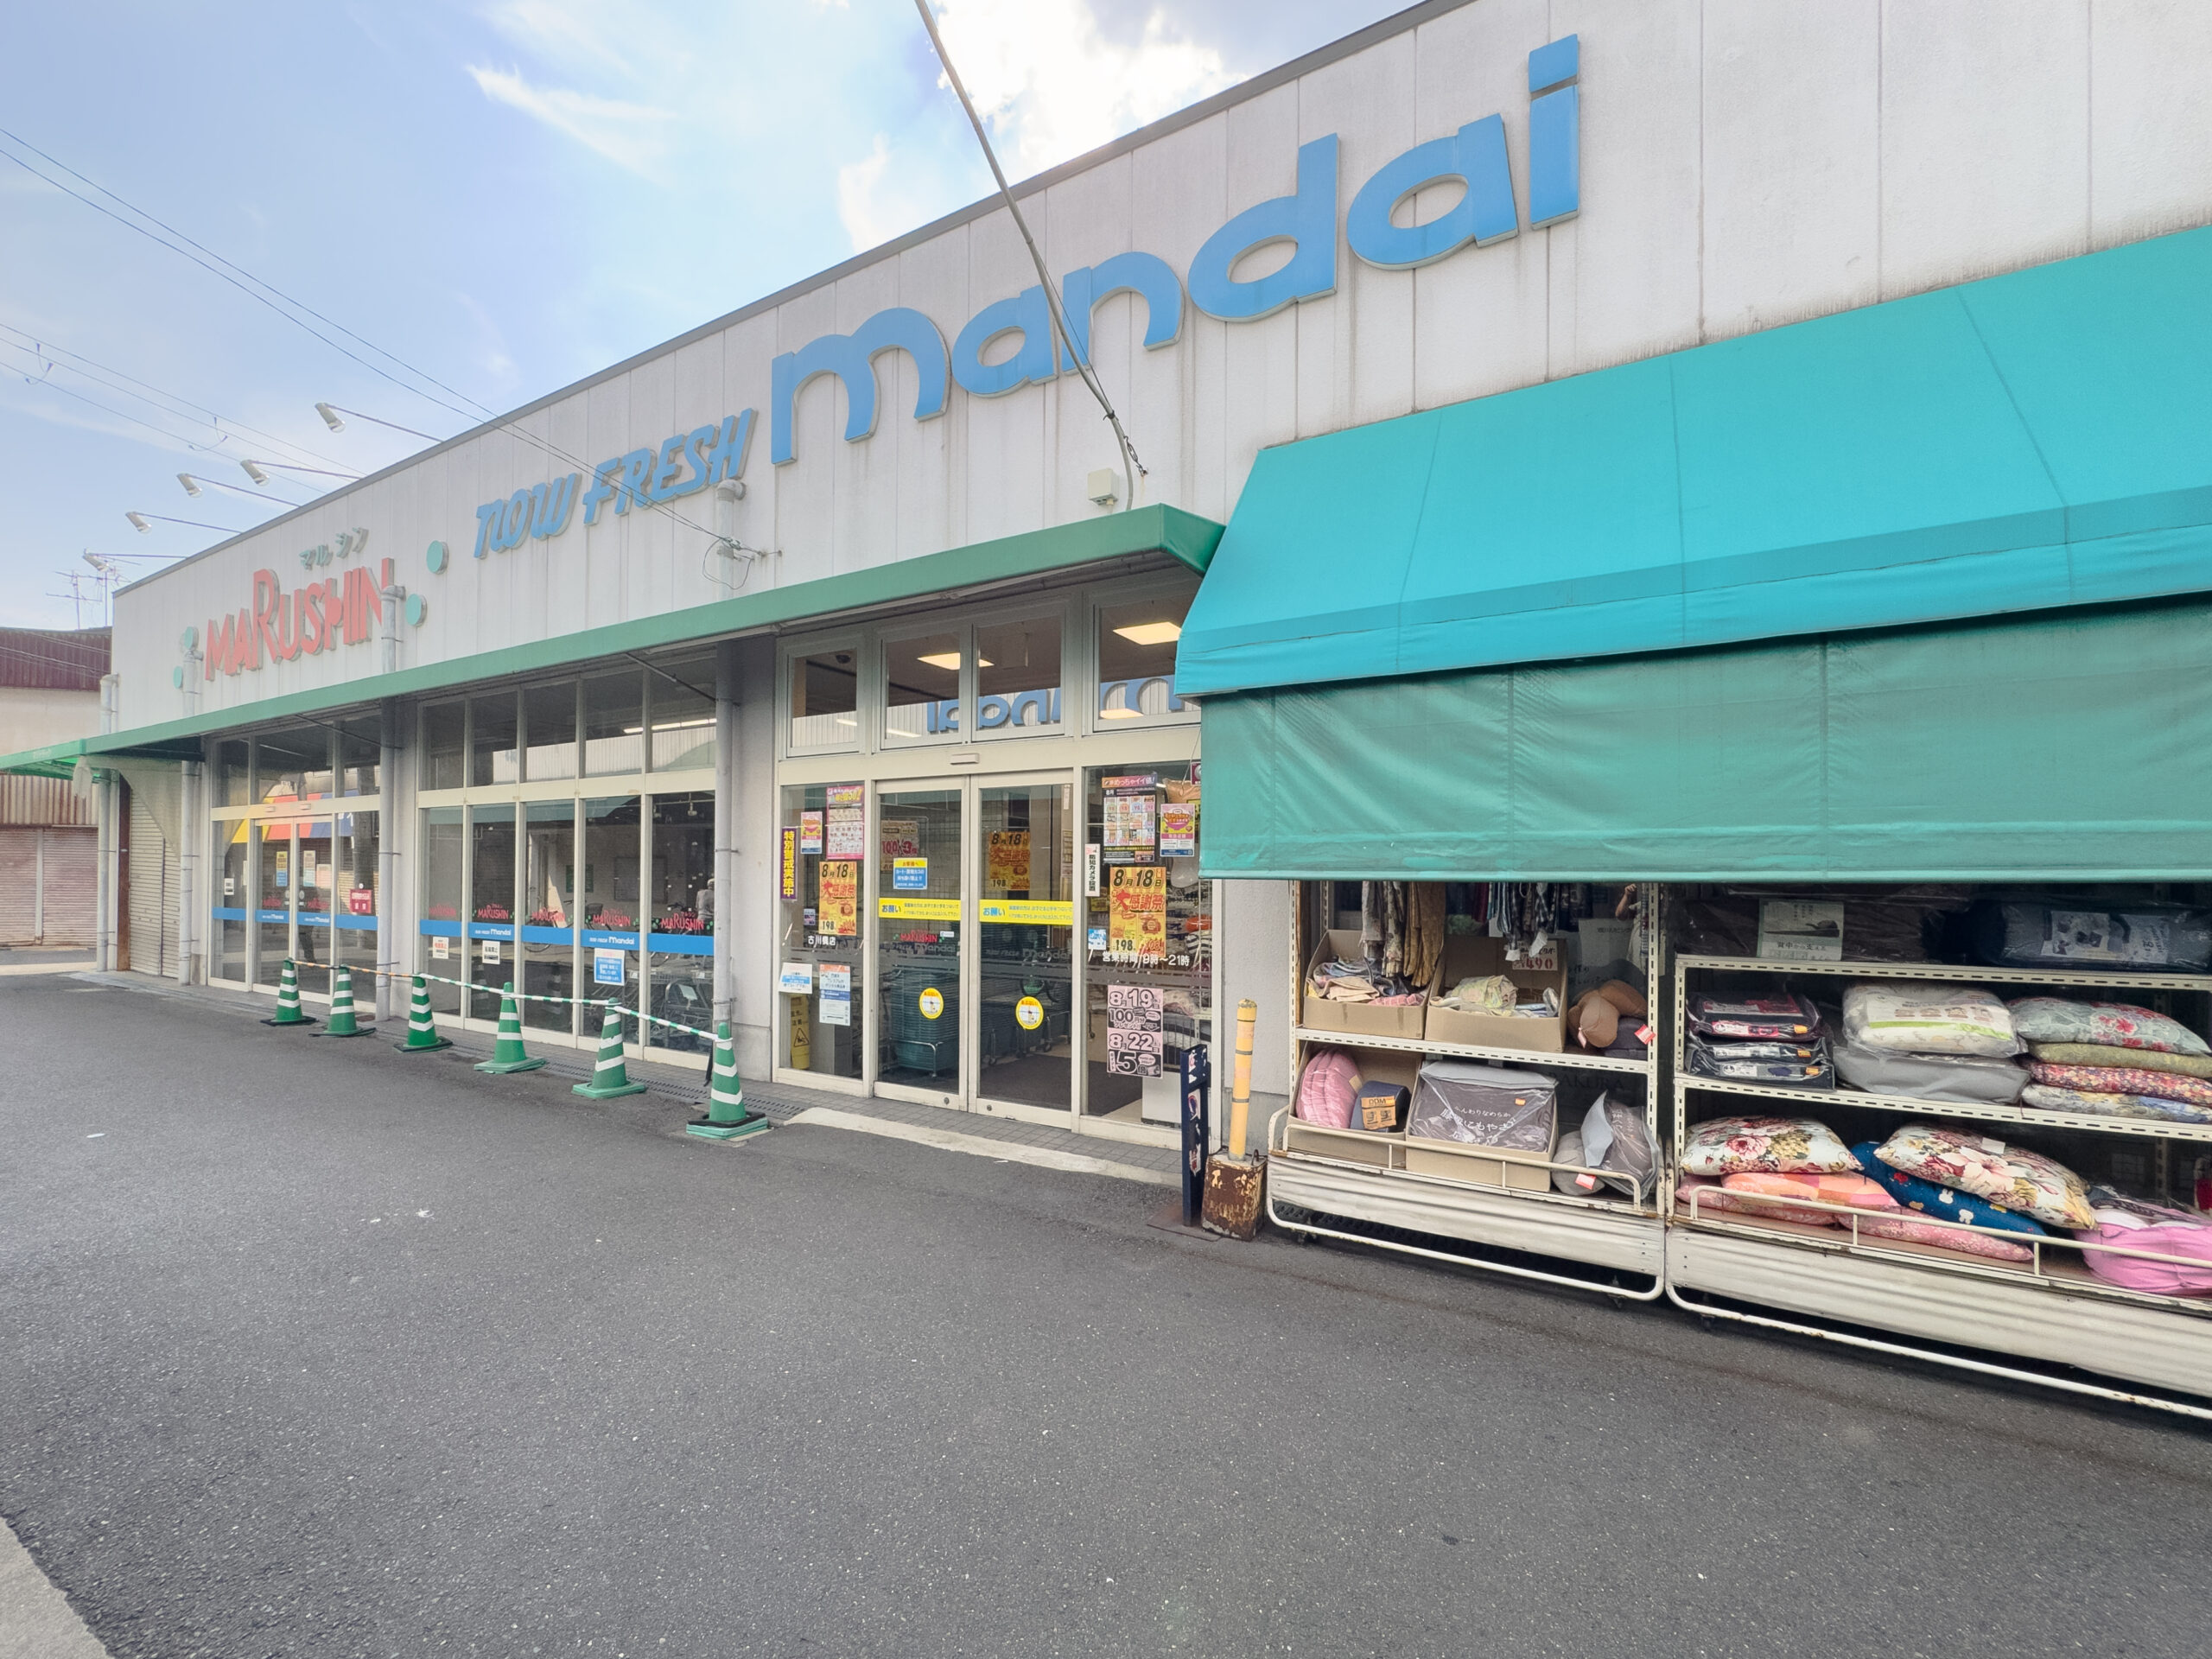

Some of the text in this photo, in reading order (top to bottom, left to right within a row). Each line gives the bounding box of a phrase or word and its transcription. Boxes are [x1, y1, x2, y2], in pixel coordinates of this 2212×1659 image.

[582, 407, 759, 526] FRESH
[771, 34, 1580, 466] mandai
[299, 527, 369, 571] マルシン
[204, 556, 396, 683] MARUSHIN
[1114, 869, 1162, 887] 8月18日
[593, 910, 631, 927] MARUSHIN
[660, 912, 704, 931] MARUSHIN
[1102, 950, 1138, 964] 営業時間
